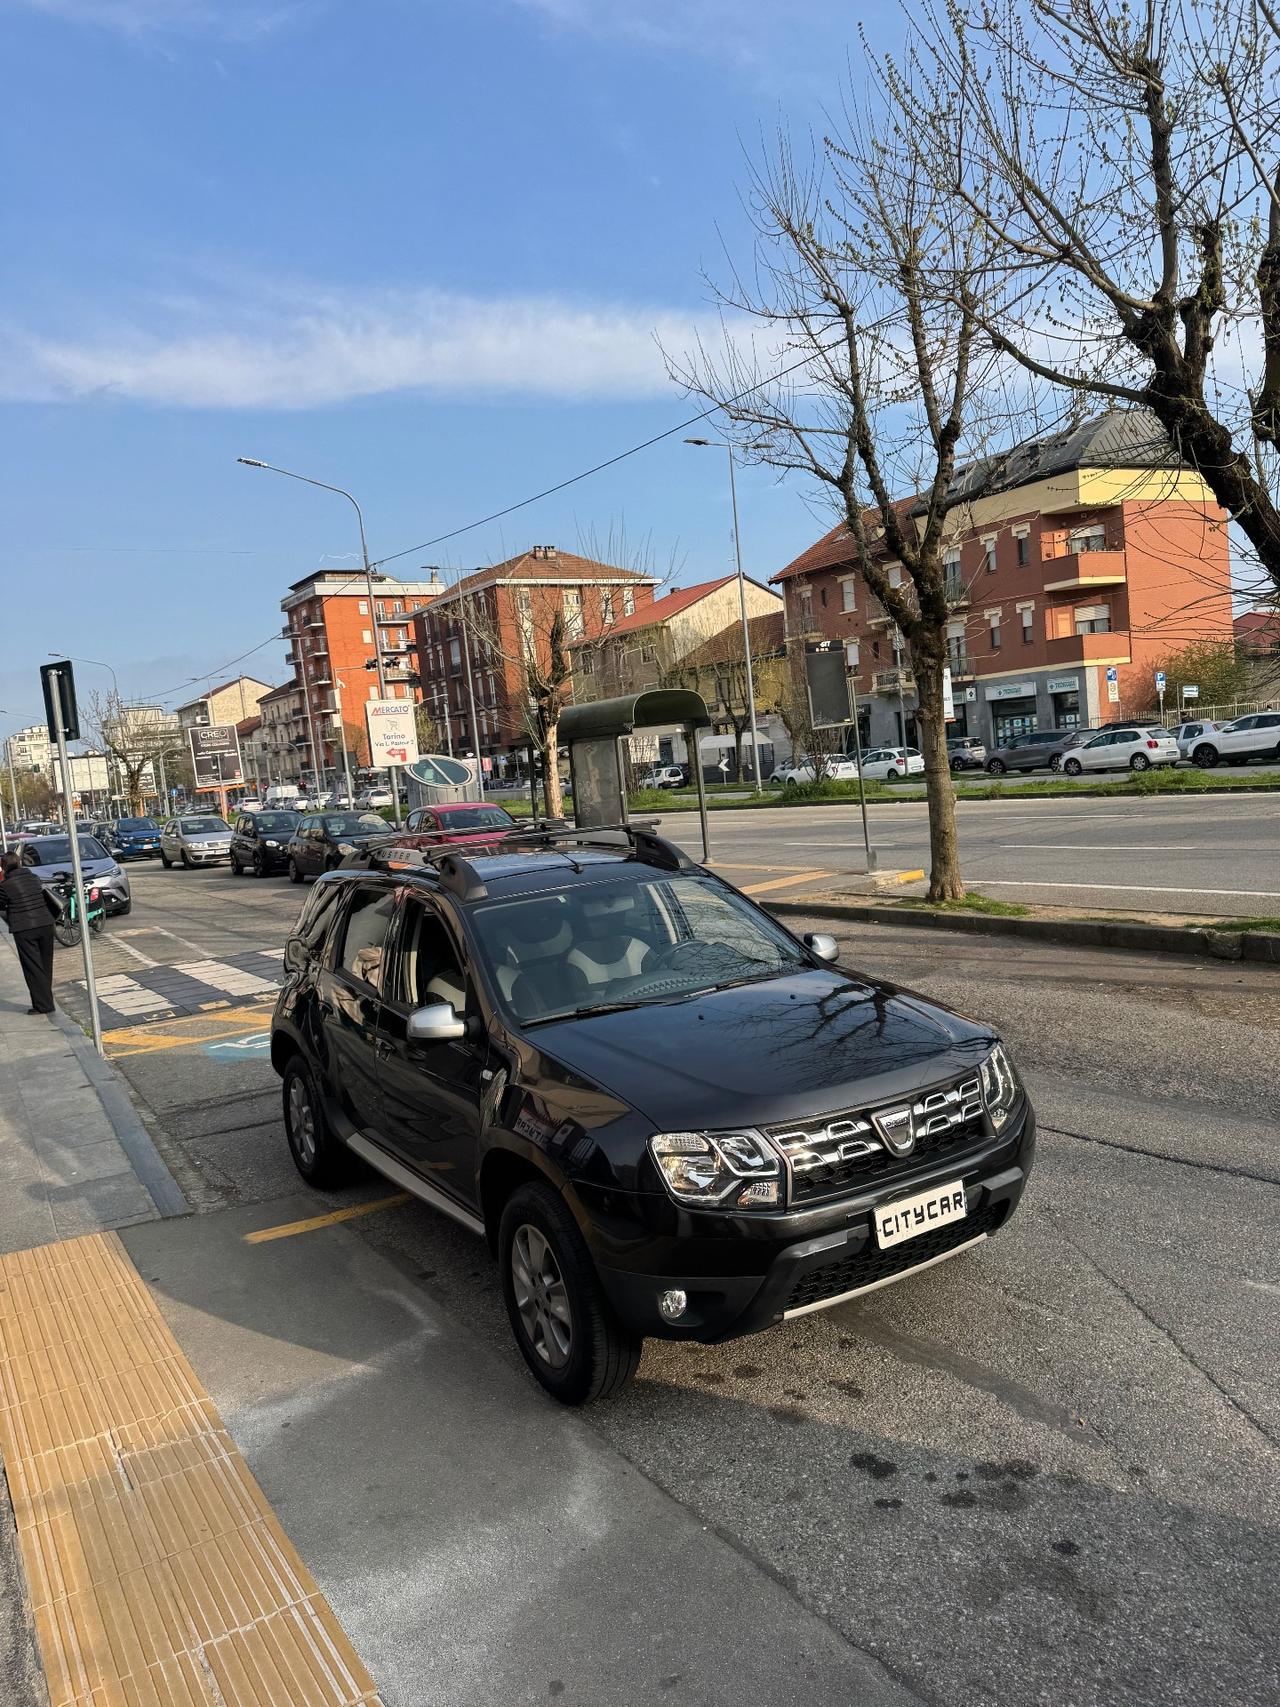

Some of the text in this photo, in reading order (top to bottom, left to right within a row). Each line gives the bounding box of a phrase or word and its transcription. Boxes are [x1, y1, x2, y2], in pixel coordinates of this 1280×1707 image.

[201, 730, 227, 739] CREO
[382, 732, 406, 740] Torino
[882, 1191, 964, 1238] CITYCAR
